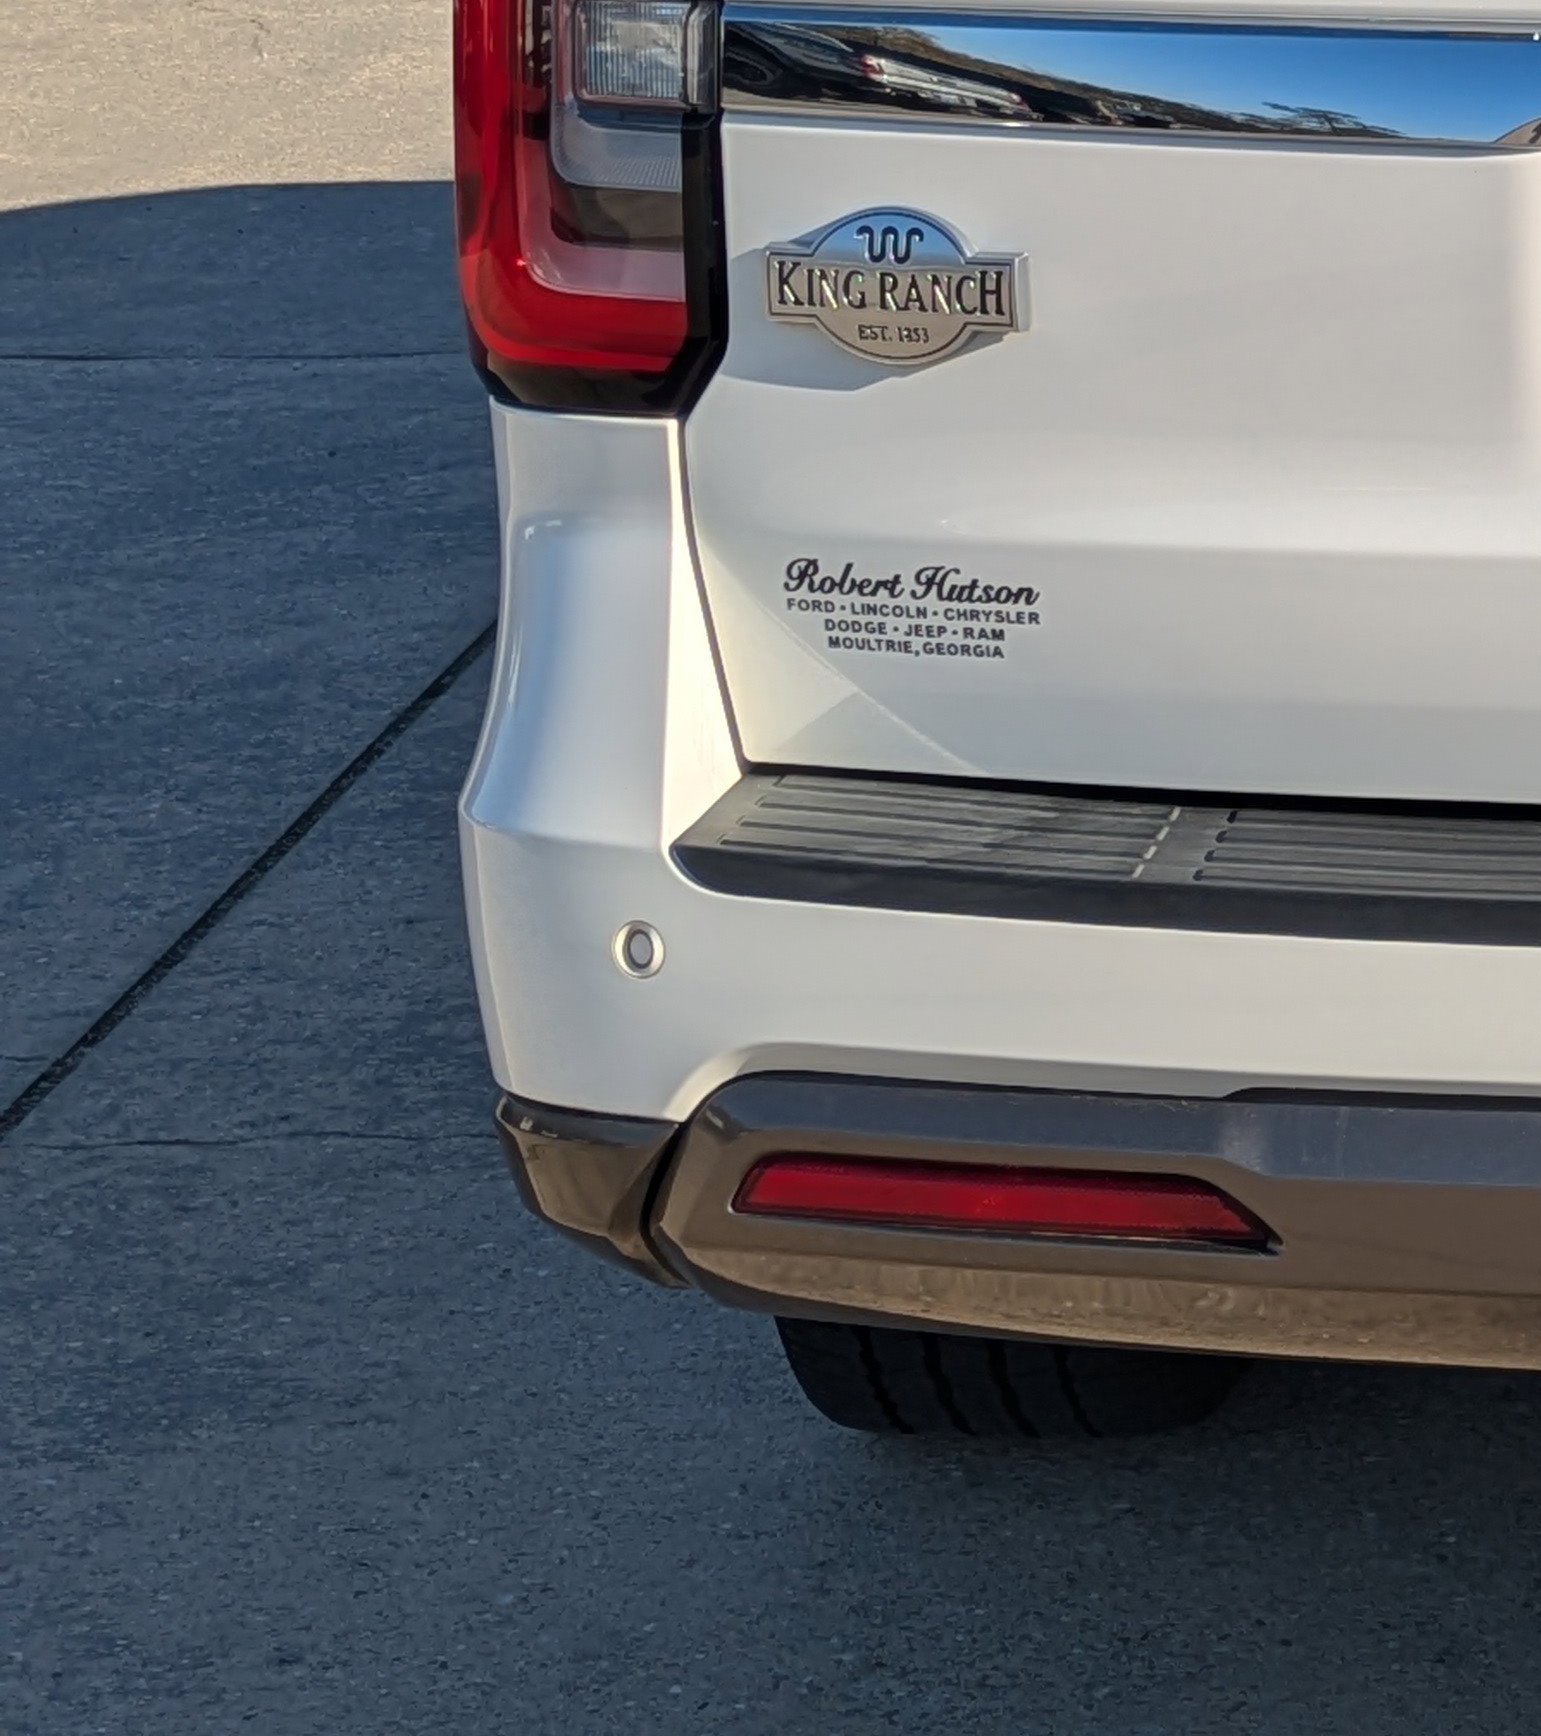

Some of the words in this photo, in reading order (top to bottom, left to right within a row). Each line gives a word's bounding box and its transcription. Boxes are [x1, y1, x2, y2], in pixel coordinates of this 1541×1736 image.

[774, 259, 867, 311] KING
[878, 269, 1006, 316] RANCH
[857, 323, 893, 342] EST.
[783, 557, 906, 599] Robert
[909, 565, 1041, 606] Hutson
[786, 597, 836, 614] FORD
[850, 601, 929, 620] LINCOLN
[942, 607, 1041, 626] CHRYSLER
[823, 618, 888, 636] DODGE
[903, 624, 948, 639] JEEP
[962, 626, 1006, 642] RAM
